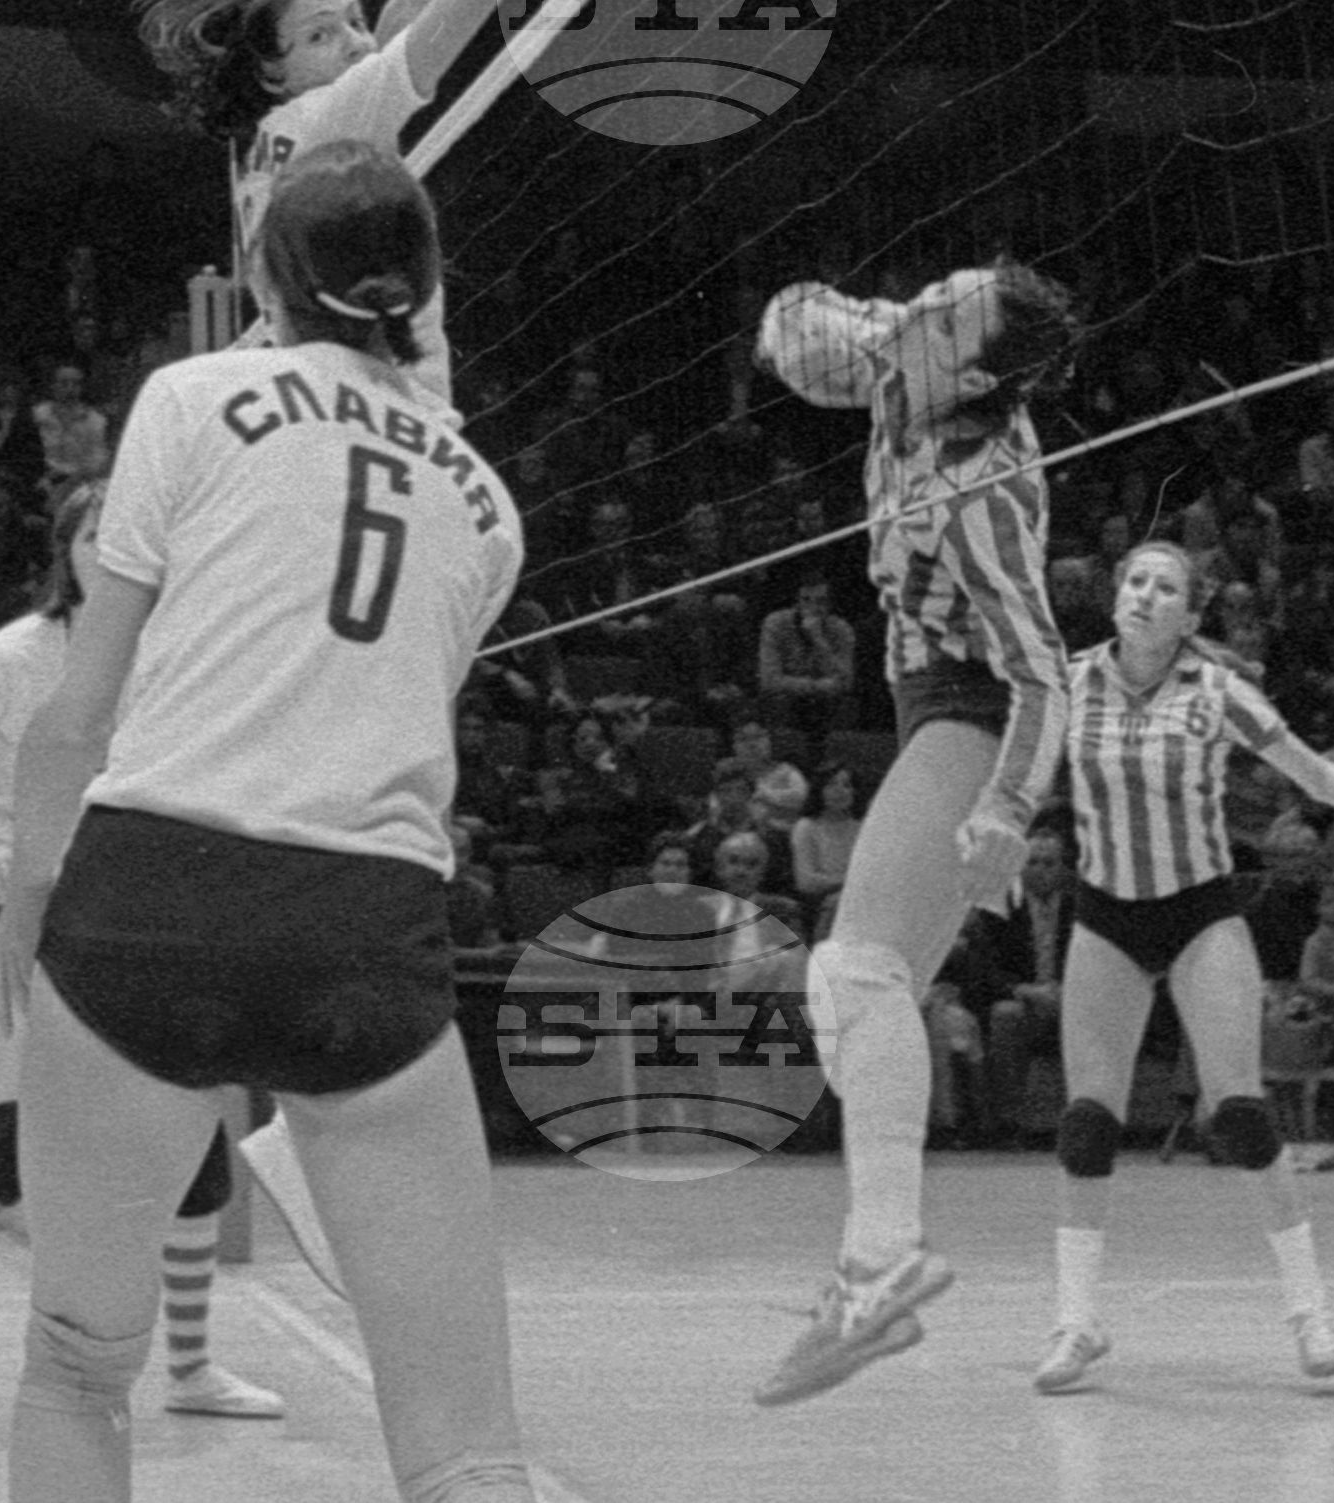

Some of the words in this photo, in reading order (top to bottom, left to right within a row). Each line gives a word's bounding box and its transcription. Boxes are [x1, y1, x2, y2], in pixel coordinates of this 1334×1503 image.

[222, 370, 500, 536] СЛАВИЯ
[327, 444, 412, 644] 6
[1185, 695, 1213, 738] 6
